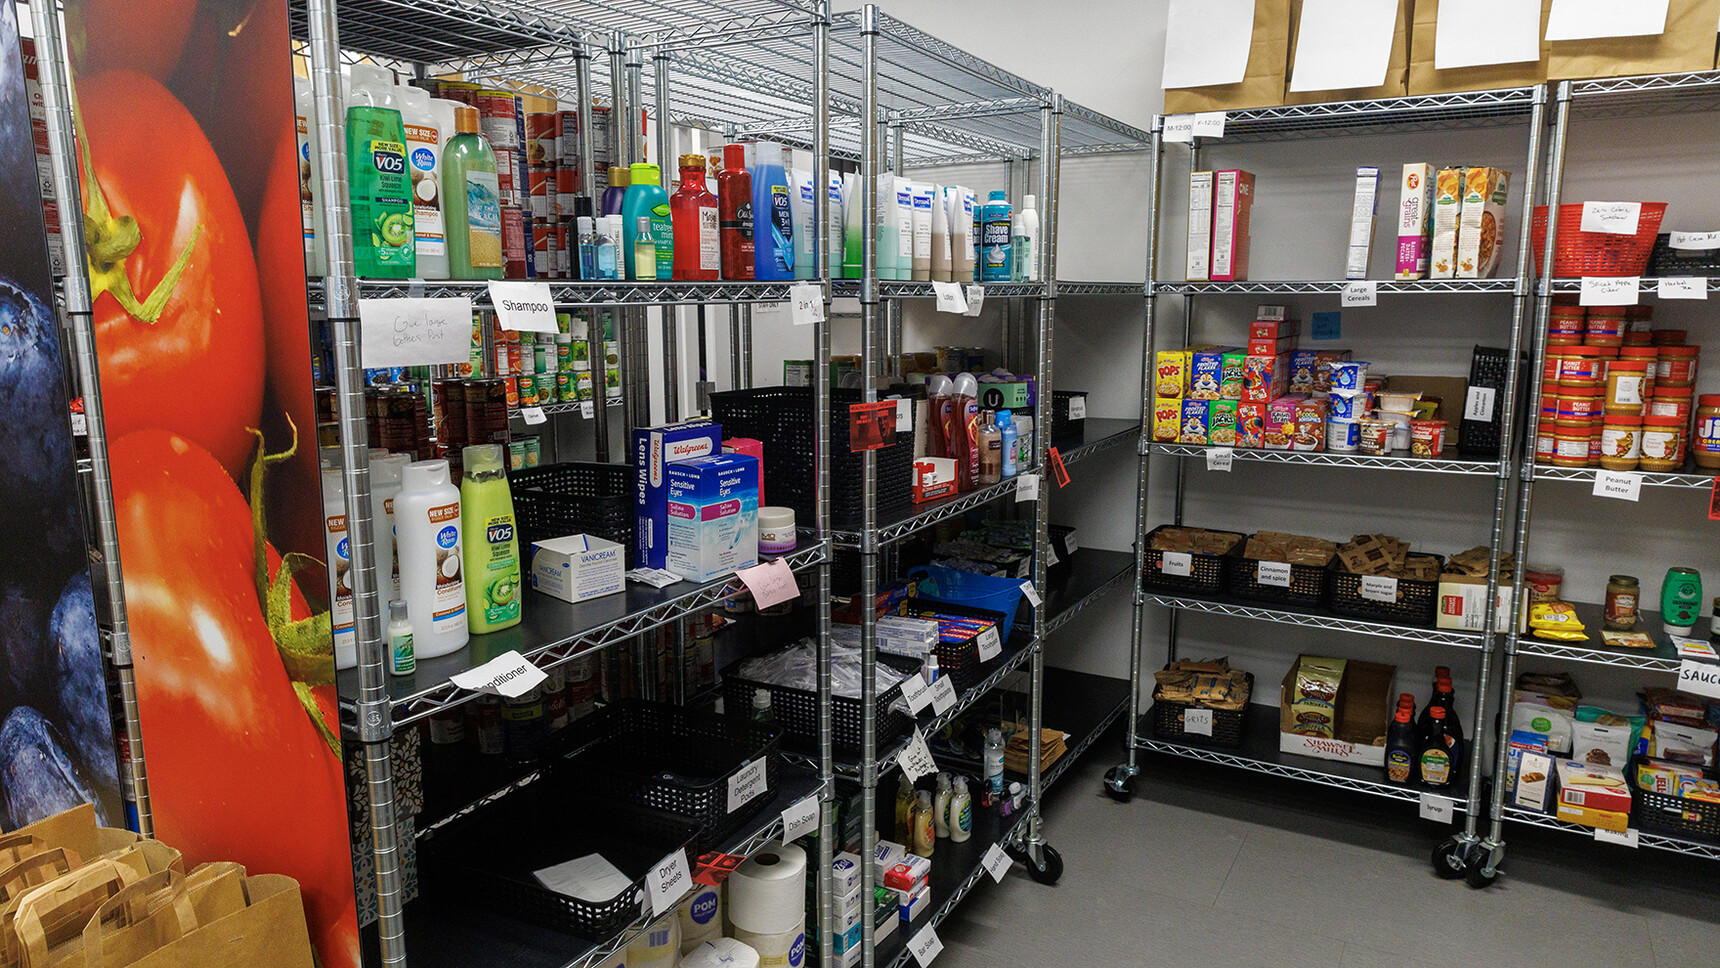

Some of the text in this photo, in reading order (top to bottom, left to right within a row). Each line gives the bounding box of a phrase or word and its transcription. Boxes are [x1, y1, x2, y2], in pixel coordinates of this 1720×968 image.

[419, 129, 431, 138] SIZE
[415, 152, 434, 162] White
[376, 156, 402, 171] VO5
[774, 196, 788, 207] VO5
[778, 210, 790, 218] MEN
[1402, 199, 1412, 228] grains
[1411, 196, 1419, 223] great
[986, 224, 1008, 235] Shave
[984, 233, 1008, 244] Cream
[502, 299, 549, 314] Shampoo
[1158, 365, 1181, 380] POPS
[1156, 409, 1178, 423] POPS
[1212, 416, 1234, 428] JACKS
[1272, 416, 1288, 424] Bran
[1698, 418, 1720, 438] Ji
[673, 443, 708, 456] Walgreens
[652, 440, 660, 482] Walgreens
[638, 438, 648, 506] Lens Wipes
[670, 478, 695, 490] Sensitive
[720, 477, 741, 488] Sensitive
[1606, 476, 1632, 486] Peanut
[670, 488, 682, 498] Eyes
[720, 487, 730, 498] Eyes
[1604, 485, 1629, 494] Butter
[429, 507, 454, 518] NEW SIZE
[670, 510, 690, 518] Solution
[720, 508, 737, 516] Solution
[328, 518, 345, 527] NEW
[440, 529, 456, 540] White
[488, 528, 512, 542] VO5
[580, 550, 616, 562] VANICREAM
[1168, 560, 1184, 568] Fruits
[1260, 566, 1288, 574] Cinnamon
[436, 584, 462, 596] Conditioner
[474, 664, 528, 690] nditioner
[1681, 669, 1720, 684] SAUC
[1186, 716, 1209, 724] GRITS
[1303, 738, 1360, 754] SHAWNEE
[1312, 746, 1350, 758] MILLS
[736, 765, 758, 784] Laundry
[734, 774, 760, 797] Detergent
[1656, 774, 1666, 792] JELL
[740, 790, 755, 804] Pods
[1426, 804, 1443, 812] Syrup
[788, 812, 816, 832] Dish Soap
[659, 859, 678, 879] Dryer
[661, 870, 682, 894] Sheets
[694, 898, 717, 914] POM
[918, 938, 935, 957] Bar Soap
